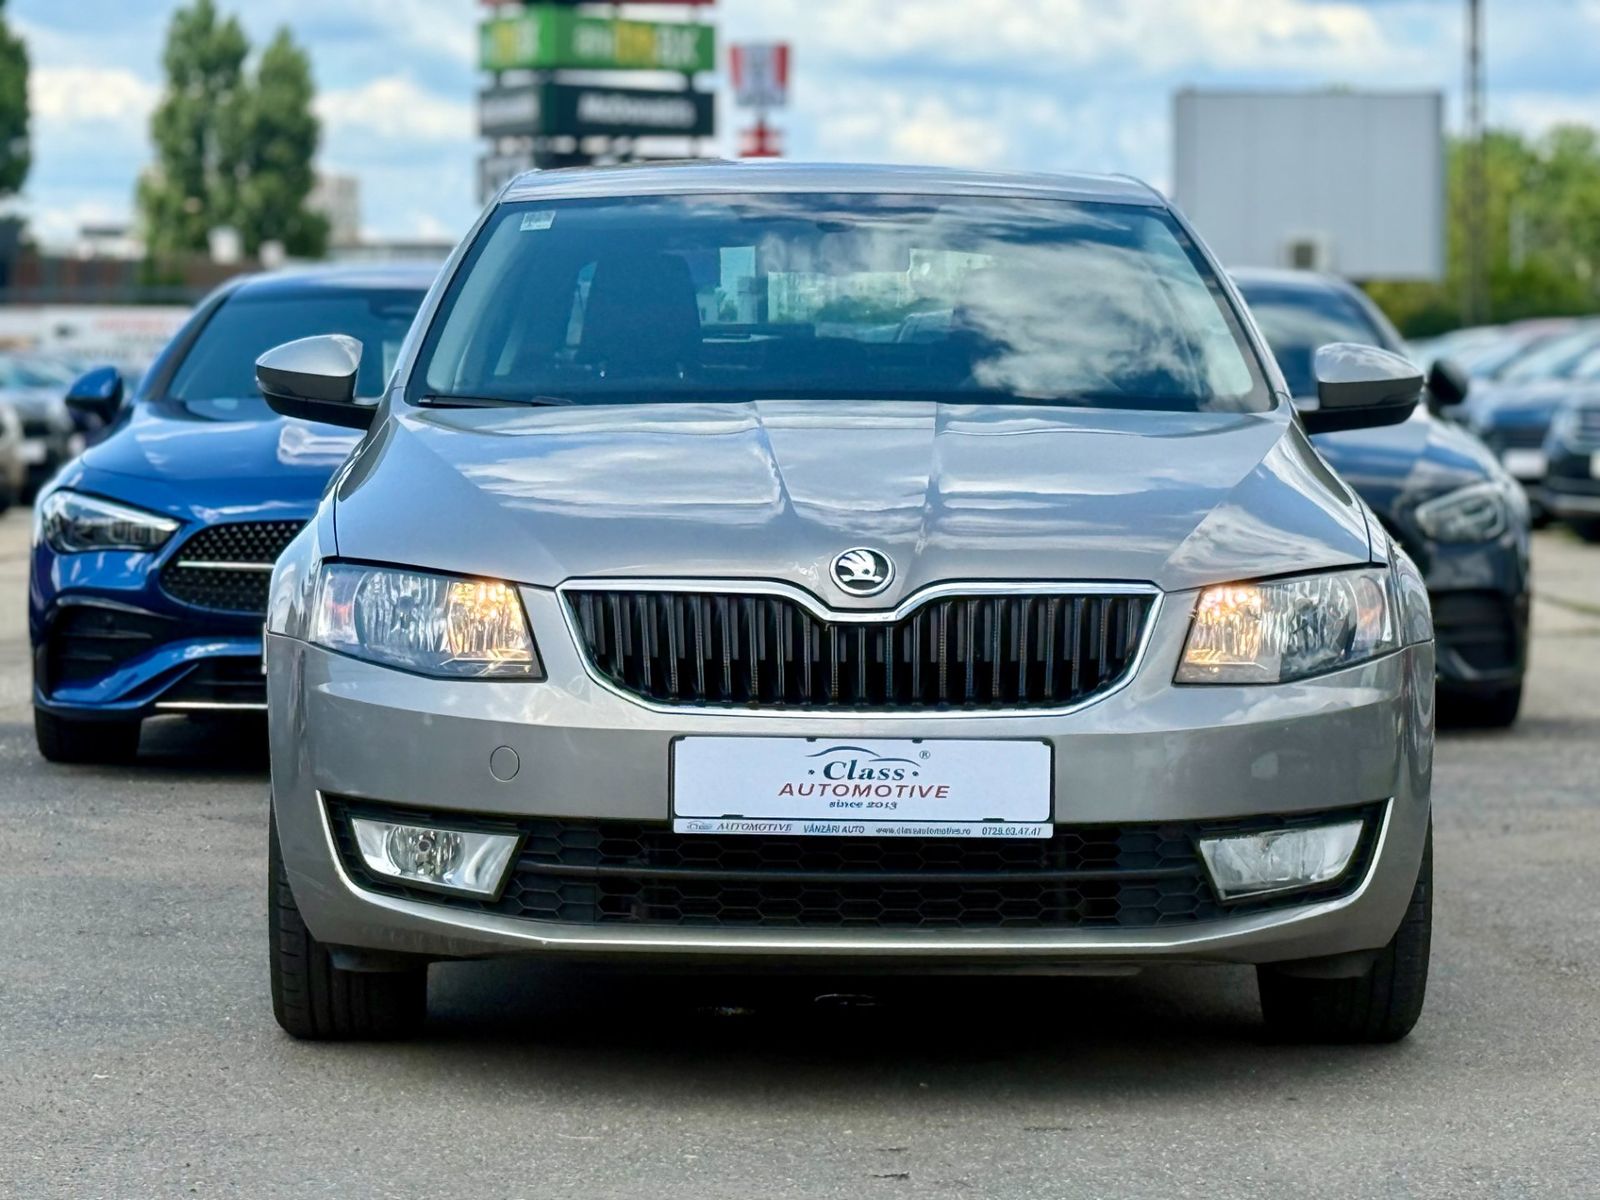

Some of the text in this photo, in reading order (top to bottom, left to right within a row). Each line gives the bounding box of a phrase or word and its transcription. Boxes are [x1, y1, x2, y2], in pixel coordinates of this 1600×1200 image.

[823, 759, 906, 780] Class
[778, 782, 950, 799] AUTOMOTIVE
[829, 799, 898, 810] since 2013
[716, 822, 792, 832] AUTOMOTIVE
[842, 825, 865, 834] AUTO
